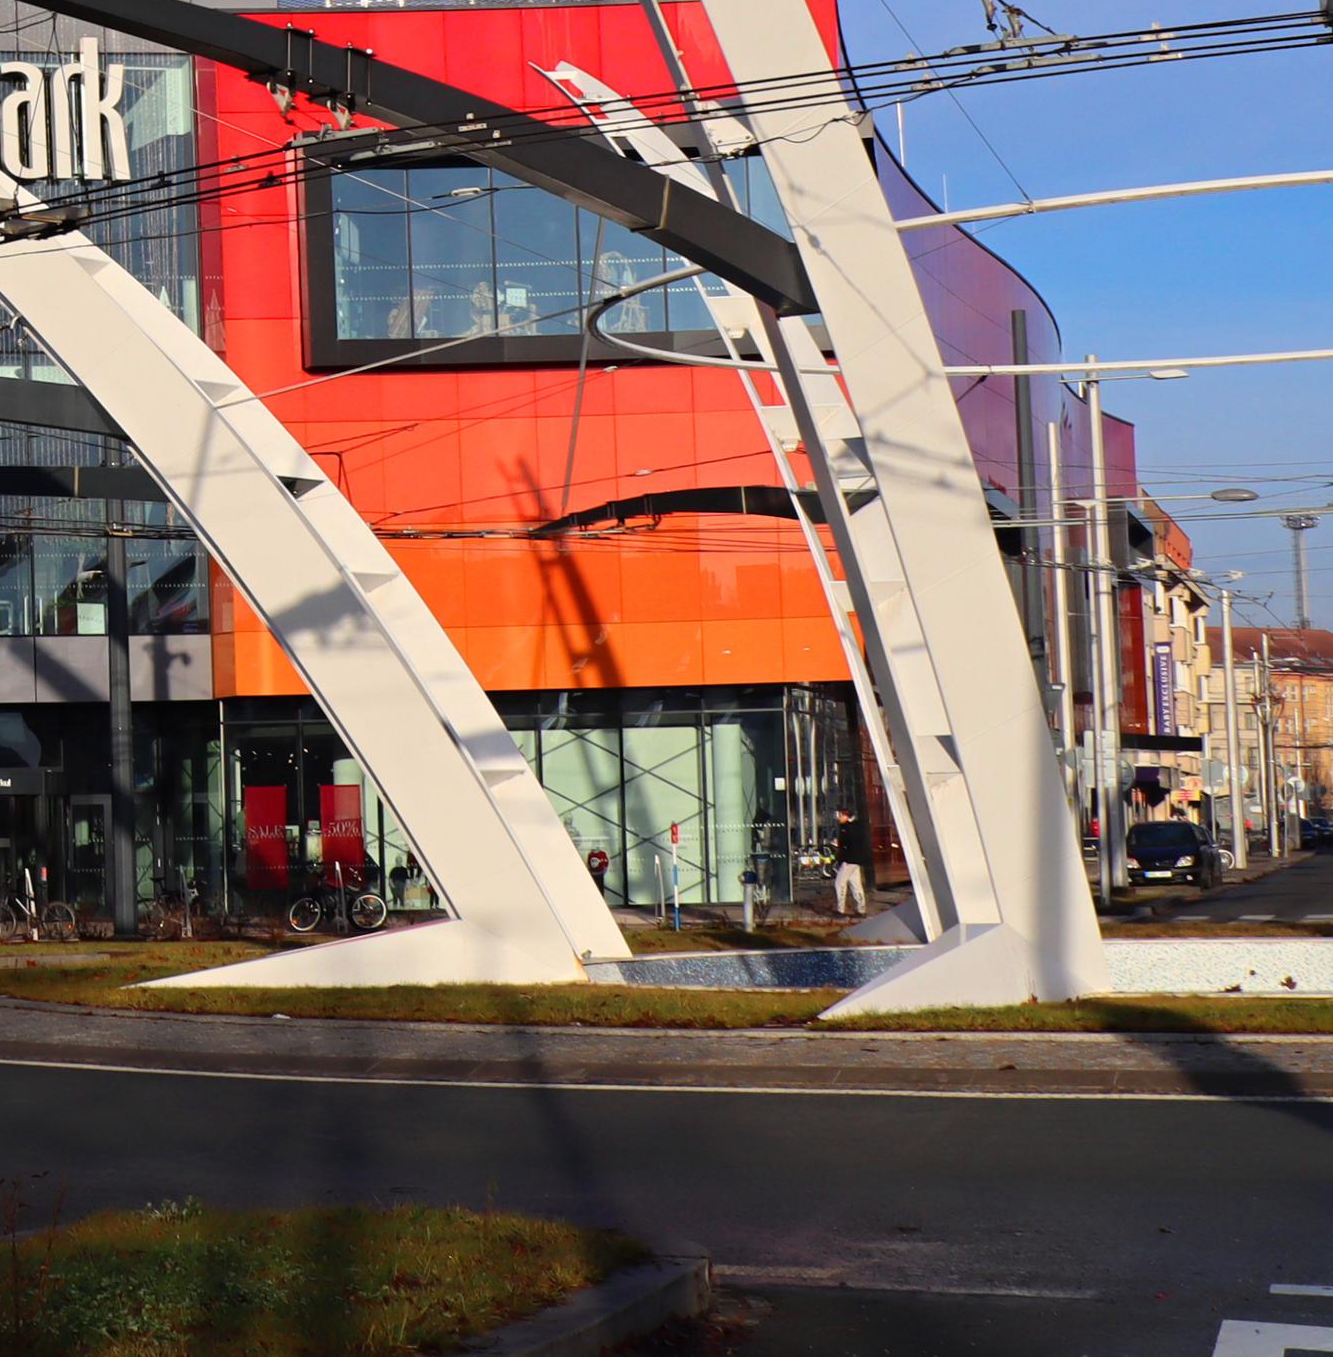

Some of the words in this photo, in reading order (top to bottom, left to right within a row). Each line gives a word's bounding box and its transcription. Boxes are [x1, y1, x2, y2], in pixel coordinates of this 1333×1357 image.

[1160, 655, 1170, 706] EXCLUSIVE
[1162, 708, 1171, 733] BABY
[248, 825, 285, 837] SALE
